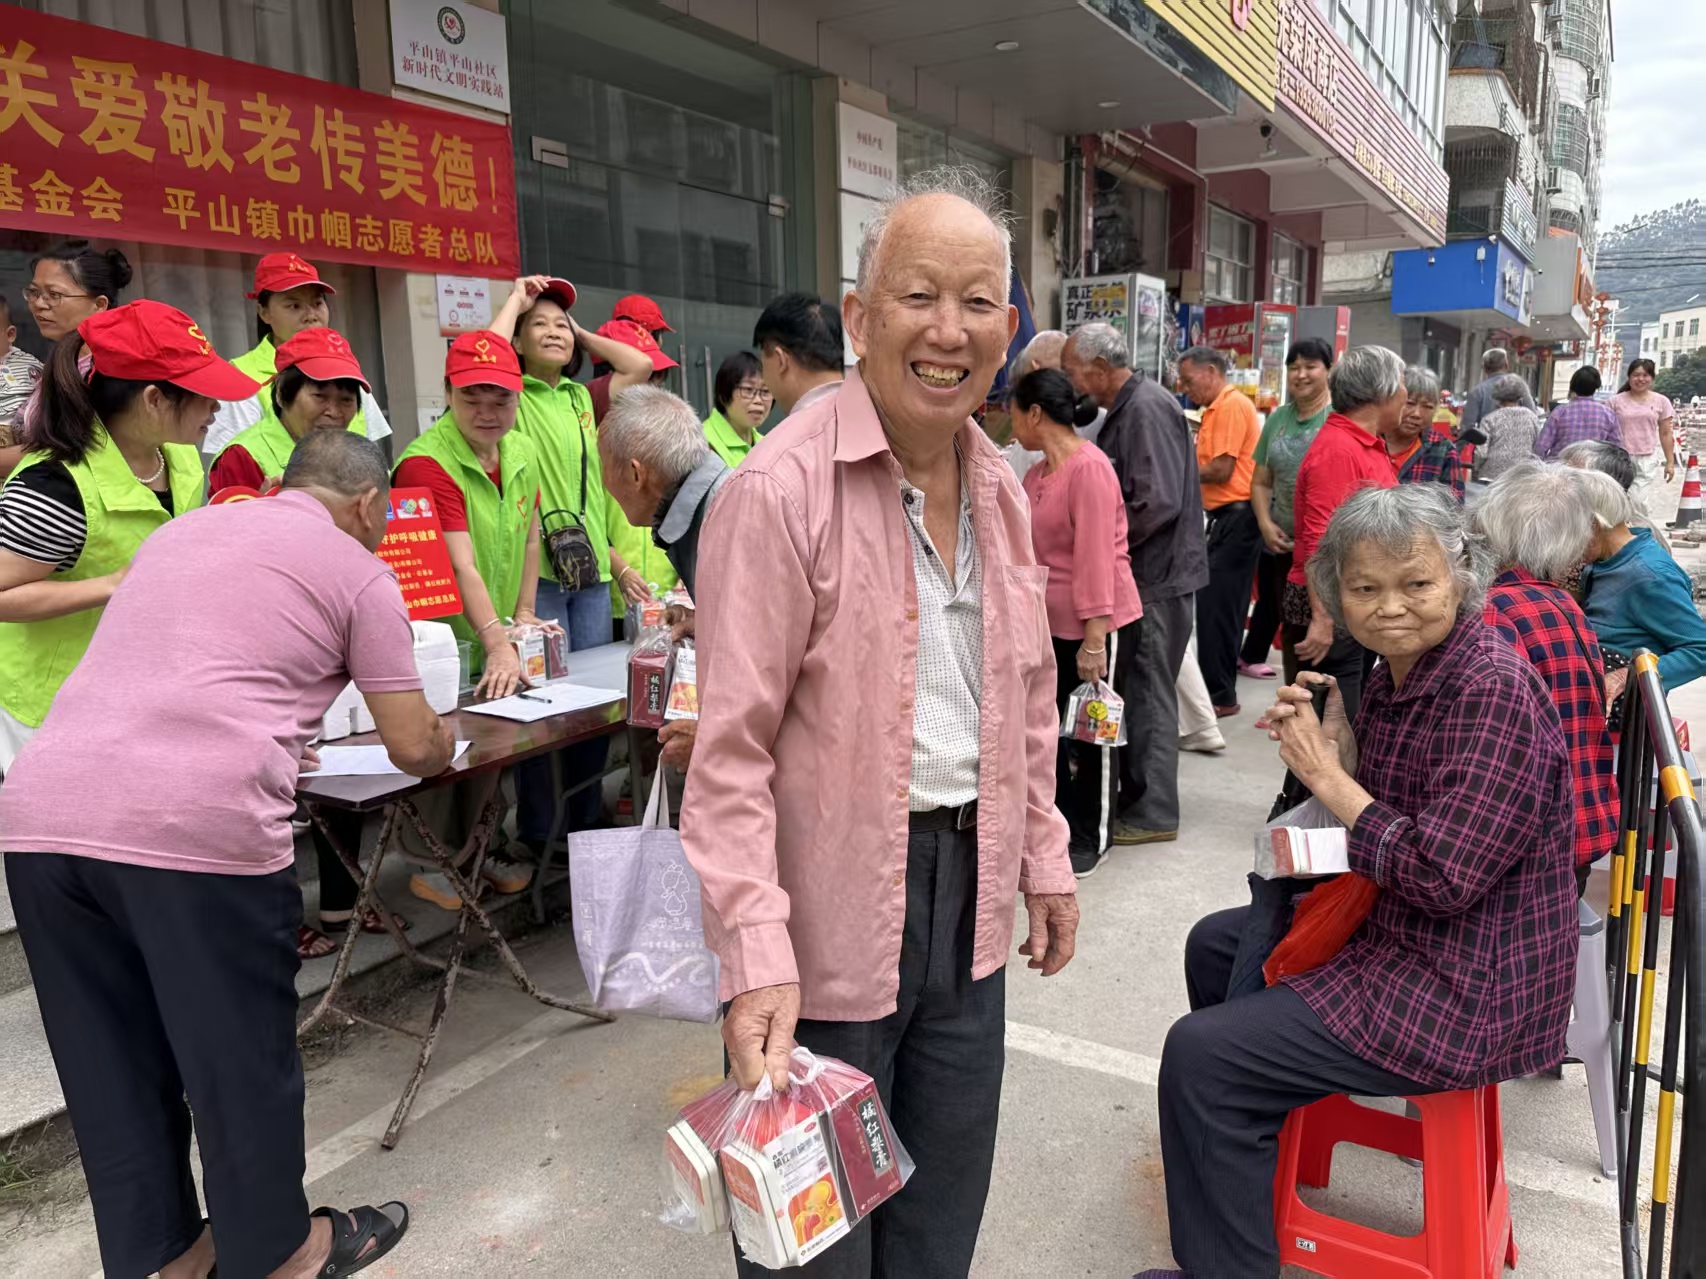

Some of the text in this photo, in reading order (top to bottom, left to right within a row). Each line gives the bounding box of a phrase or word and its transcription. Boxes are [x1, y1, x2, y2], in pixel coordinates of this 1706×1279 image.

[402, 55, 505, 99] 新时代文明实践站
[408, 39, 498, 80] 平山镇平山社区
[0, 39, 498, 214] 关爱敬老传美德！
[163, 187, 499, 266] 平山镇巾帼志愿者总队
